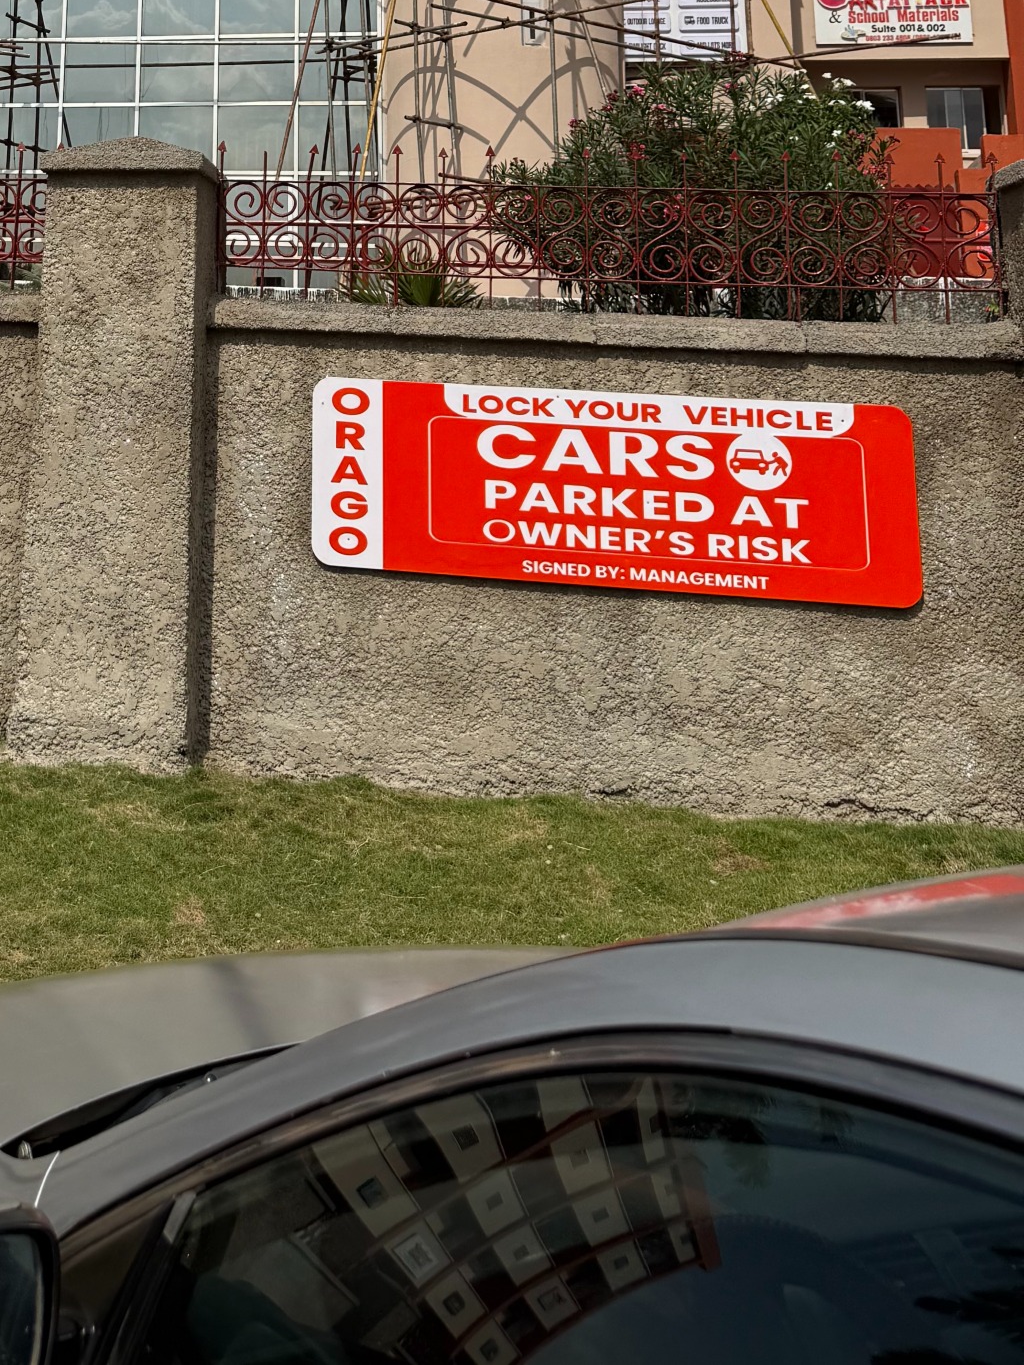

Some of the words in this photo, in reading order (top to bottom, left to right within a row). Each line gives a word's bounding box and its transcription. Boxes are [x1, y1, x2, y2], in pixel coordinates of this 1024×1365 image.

[696, 16, 710, 25] FOOD
[711, 16, 728, 24] TRUCK
[829, 10, 842, 24] &
[848, 10, 889, 24] School
[897, 8, 959, 23] Materials
[871, 24, 896, 33] Suite
[926, 23, 946, 32] 002
[462, 393, 554, 418] LOCK
[565, 399, 661, 423] YOUR
[683, 404, 834, 432] VEHICLE
[331, 387, 371, 556] ORAGO
[476, 424, 715, 480] CARS
[484, 479, 715, 523] PARKED
[730, 495, 809, 529] AT
[482, 519, 695, 557] OWNER'S
[707, 532, 811, 564] RISK
[522, 559, 591, 578] SIGNED
[595, 565, 625, 582] BY:
[629, 567, 769, 590] MANAGEMENT
